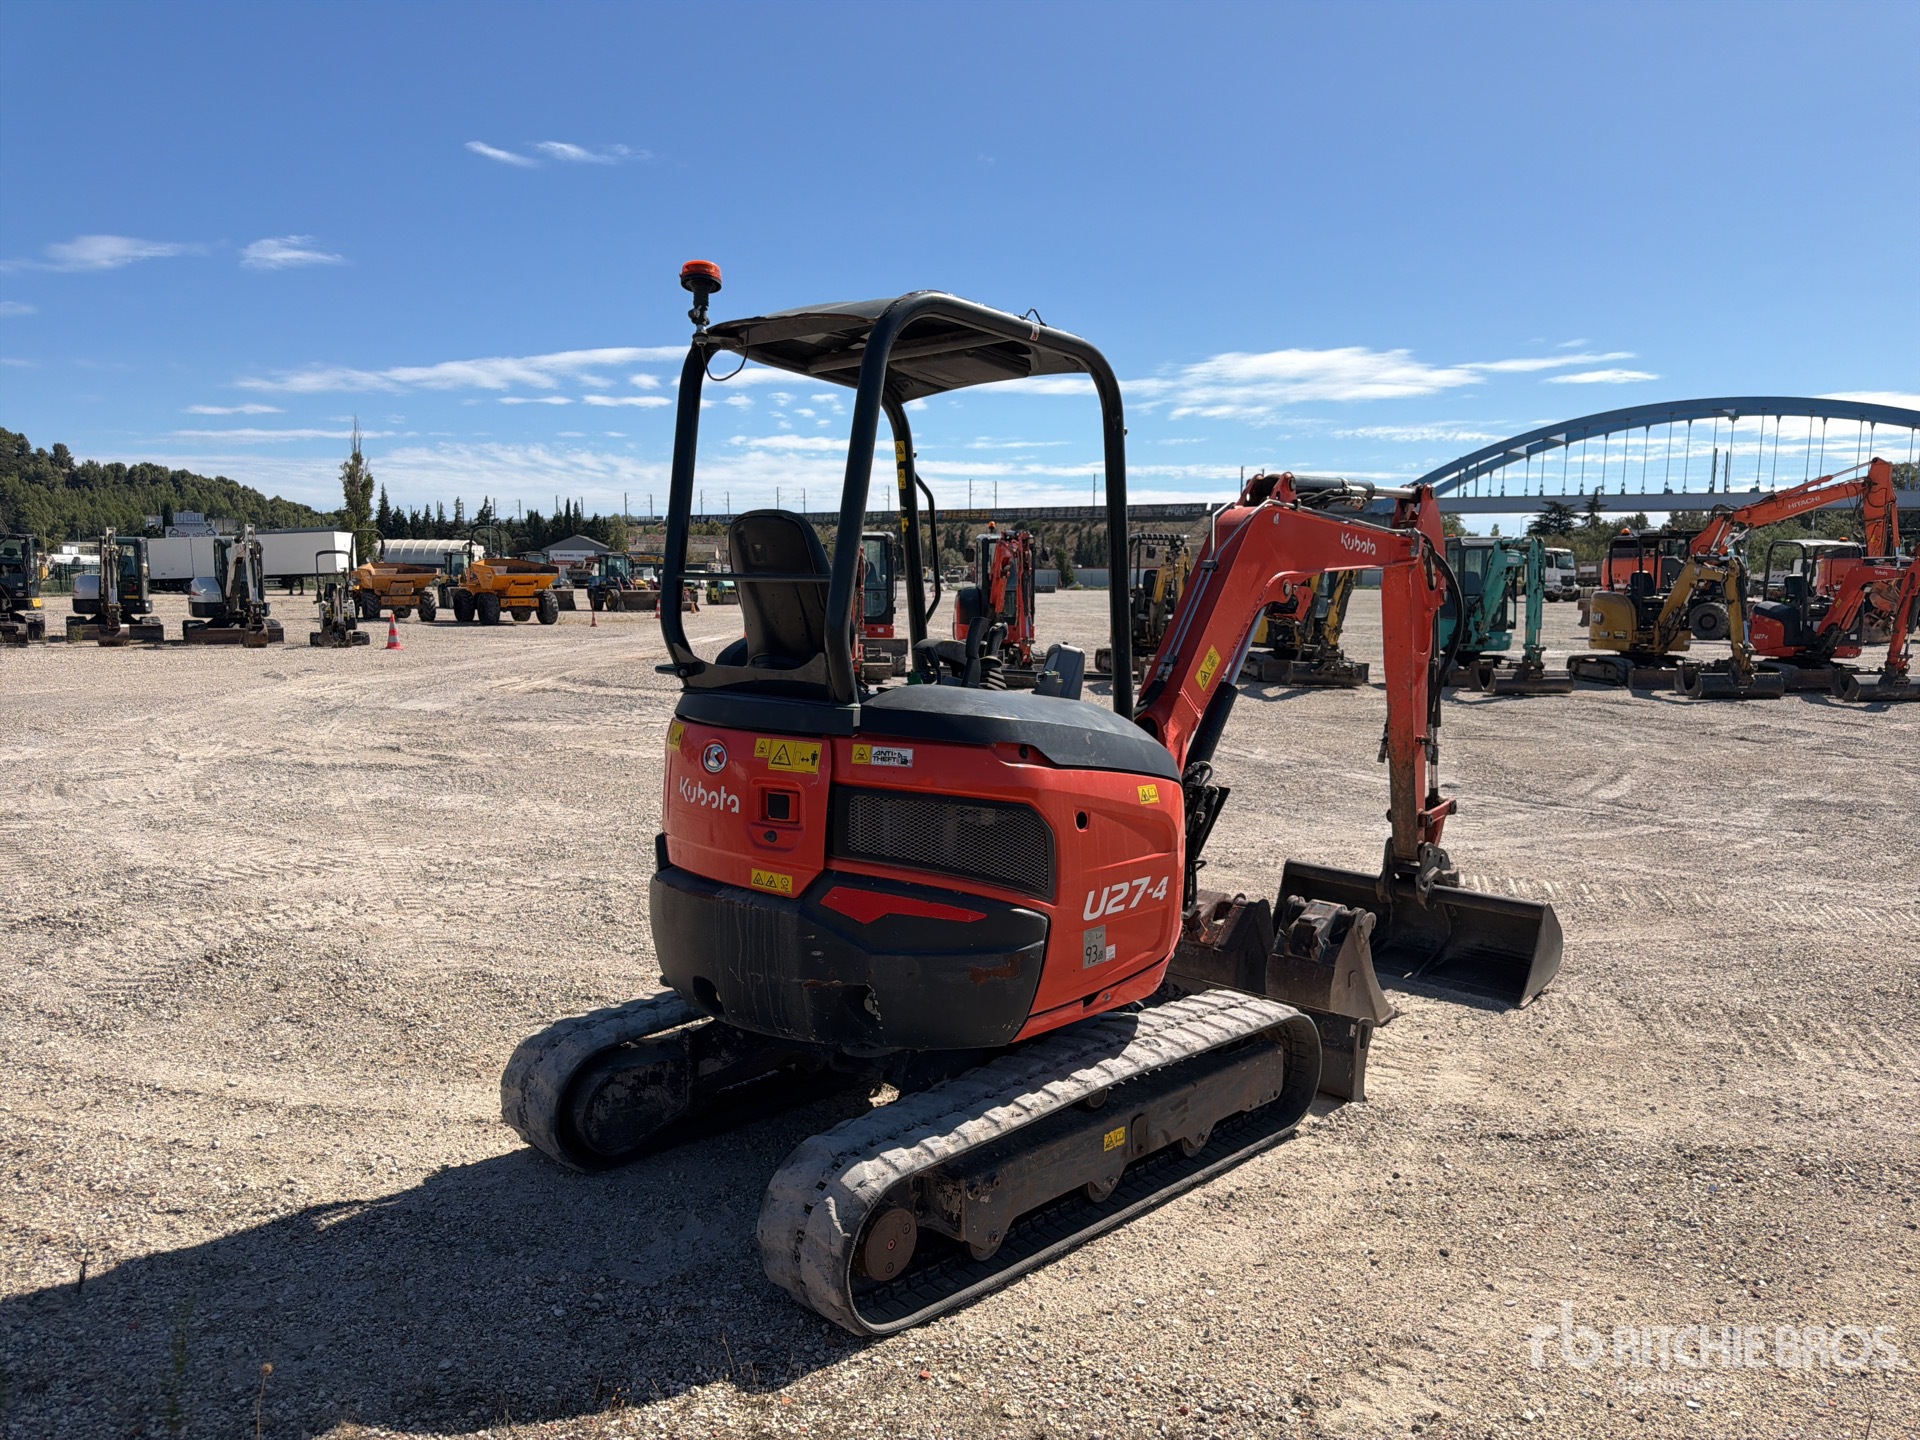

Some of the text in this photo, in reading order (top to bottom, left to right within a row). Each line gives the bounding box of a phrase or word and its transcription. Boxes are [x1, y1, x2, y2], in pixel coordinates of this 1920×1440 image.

[1788, 496, 1821, 510] HITACHI
[1340, 532, 1376, 556] Kubota
[679, 775, 740, 814] Kubota
[1082, 876, 1169, 921] U27-4
